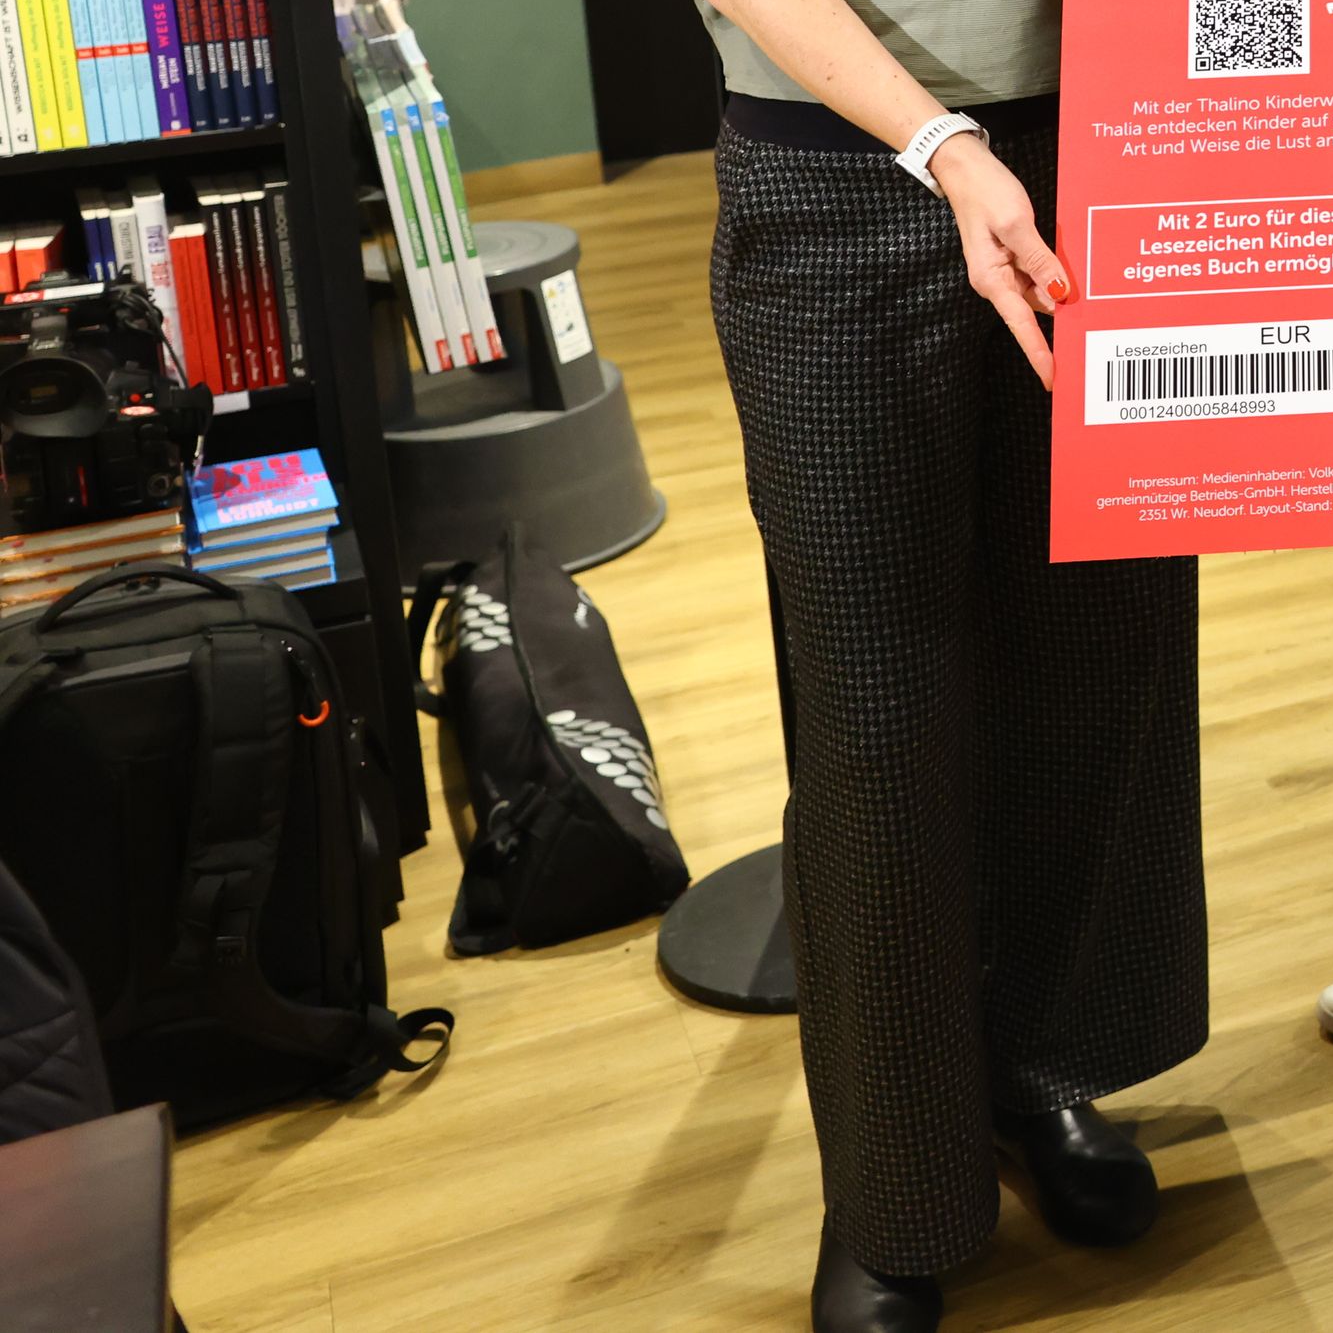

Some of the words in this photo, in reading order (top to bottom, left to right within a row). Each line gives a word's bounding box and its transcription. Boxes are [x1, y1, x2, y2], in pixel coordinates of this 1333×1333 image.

[153, 3, 170, 48] WEISE
[1133, 99, 1160, 115] Mit
[1164, 97, 1192, 114] der
[1198, 96, 1261, 111] Thalino
[1092, 121, 1142, 137] Thalia
[1147, 117, 1236, 135] entdecken
[1242, 114, 1296, 132] Kinder
[1301, 112, 1328, 128] auf
[1122, 141, 1146, 156] Art
[1152, 139, 1184, 155] und
[1190, 137, 1241, 153] Weise
[1245, 135, 1270, 151] die
[1276, 134, 1310, 149] Lust
[1157, 213, 1191, 232] Mit
[1196, 213, 1208, 229] 2
[1213, 211, 1260, 228] Euro
[1265, 209, 1296, 226] für
[1139, 233, 1264, 256] Lesezeichen
[1124, 261, 1202, 282] eigenes
[1207, 255, 1259, 275] Buch
[1261, 326, 1310, 345] EUR
[1115, 341, 1208, 358] Lesezeichen
[1120, 401, 1276, 420] 00012400005848993
[1128, 475, 1198, 491] Impressum:
[1202, 468, 1306, 486] Medieninhaberin:
[1096, 490, 1187, 510] gemeinnützige
[1191, 486, 1287, 503] Betriebs-GmbH.
[1138, 507, 1167, 520] 2351
[1171, 506, 1190, 519] Wr.
[1194, 501, 1246, 518] Neudorf.
[1249, 498, 1332, 516] Layout-Stand:
